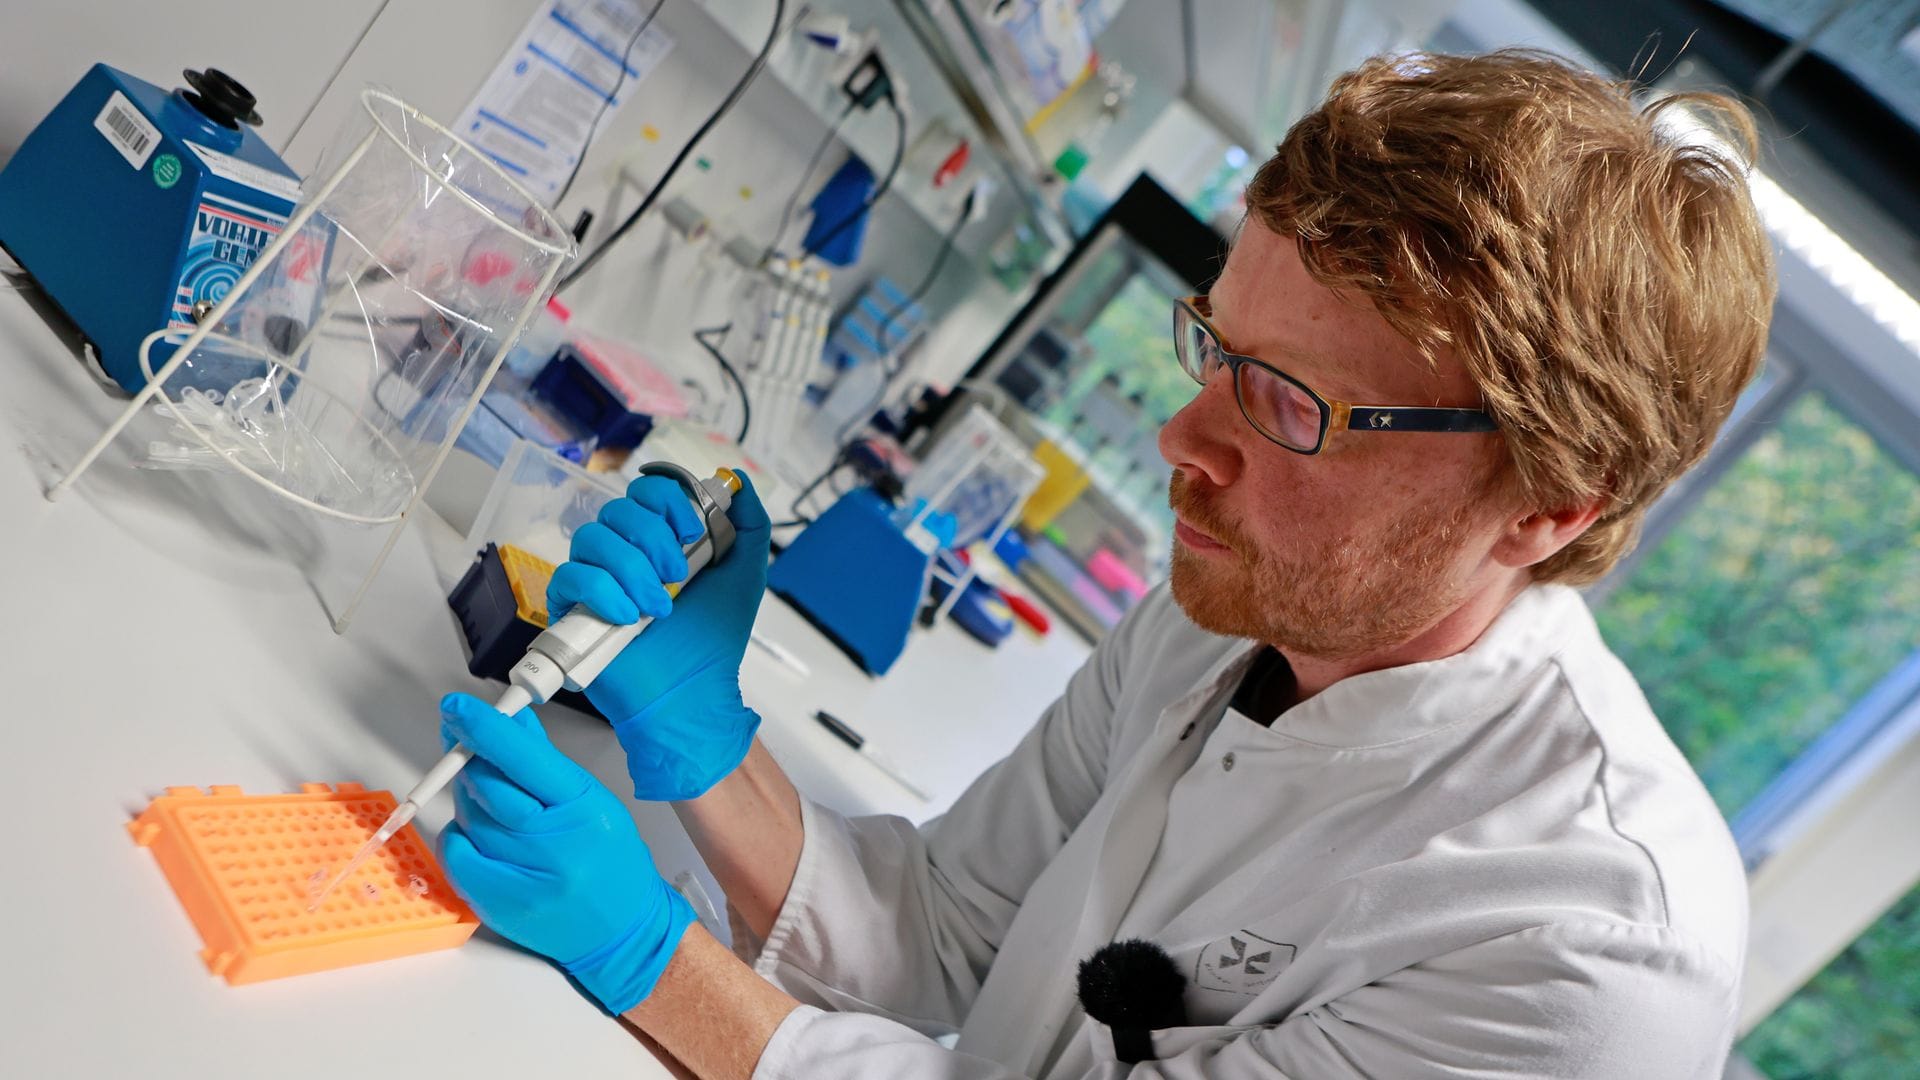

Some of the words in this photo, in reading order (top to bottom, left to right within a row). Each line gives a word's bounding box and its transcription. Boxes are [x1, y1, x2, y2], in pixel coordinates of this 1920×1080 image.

[199, 211, 276, 248] VORTE
[213, 240, 259, 266] GEN
[524, 661, 539, 673] 200
